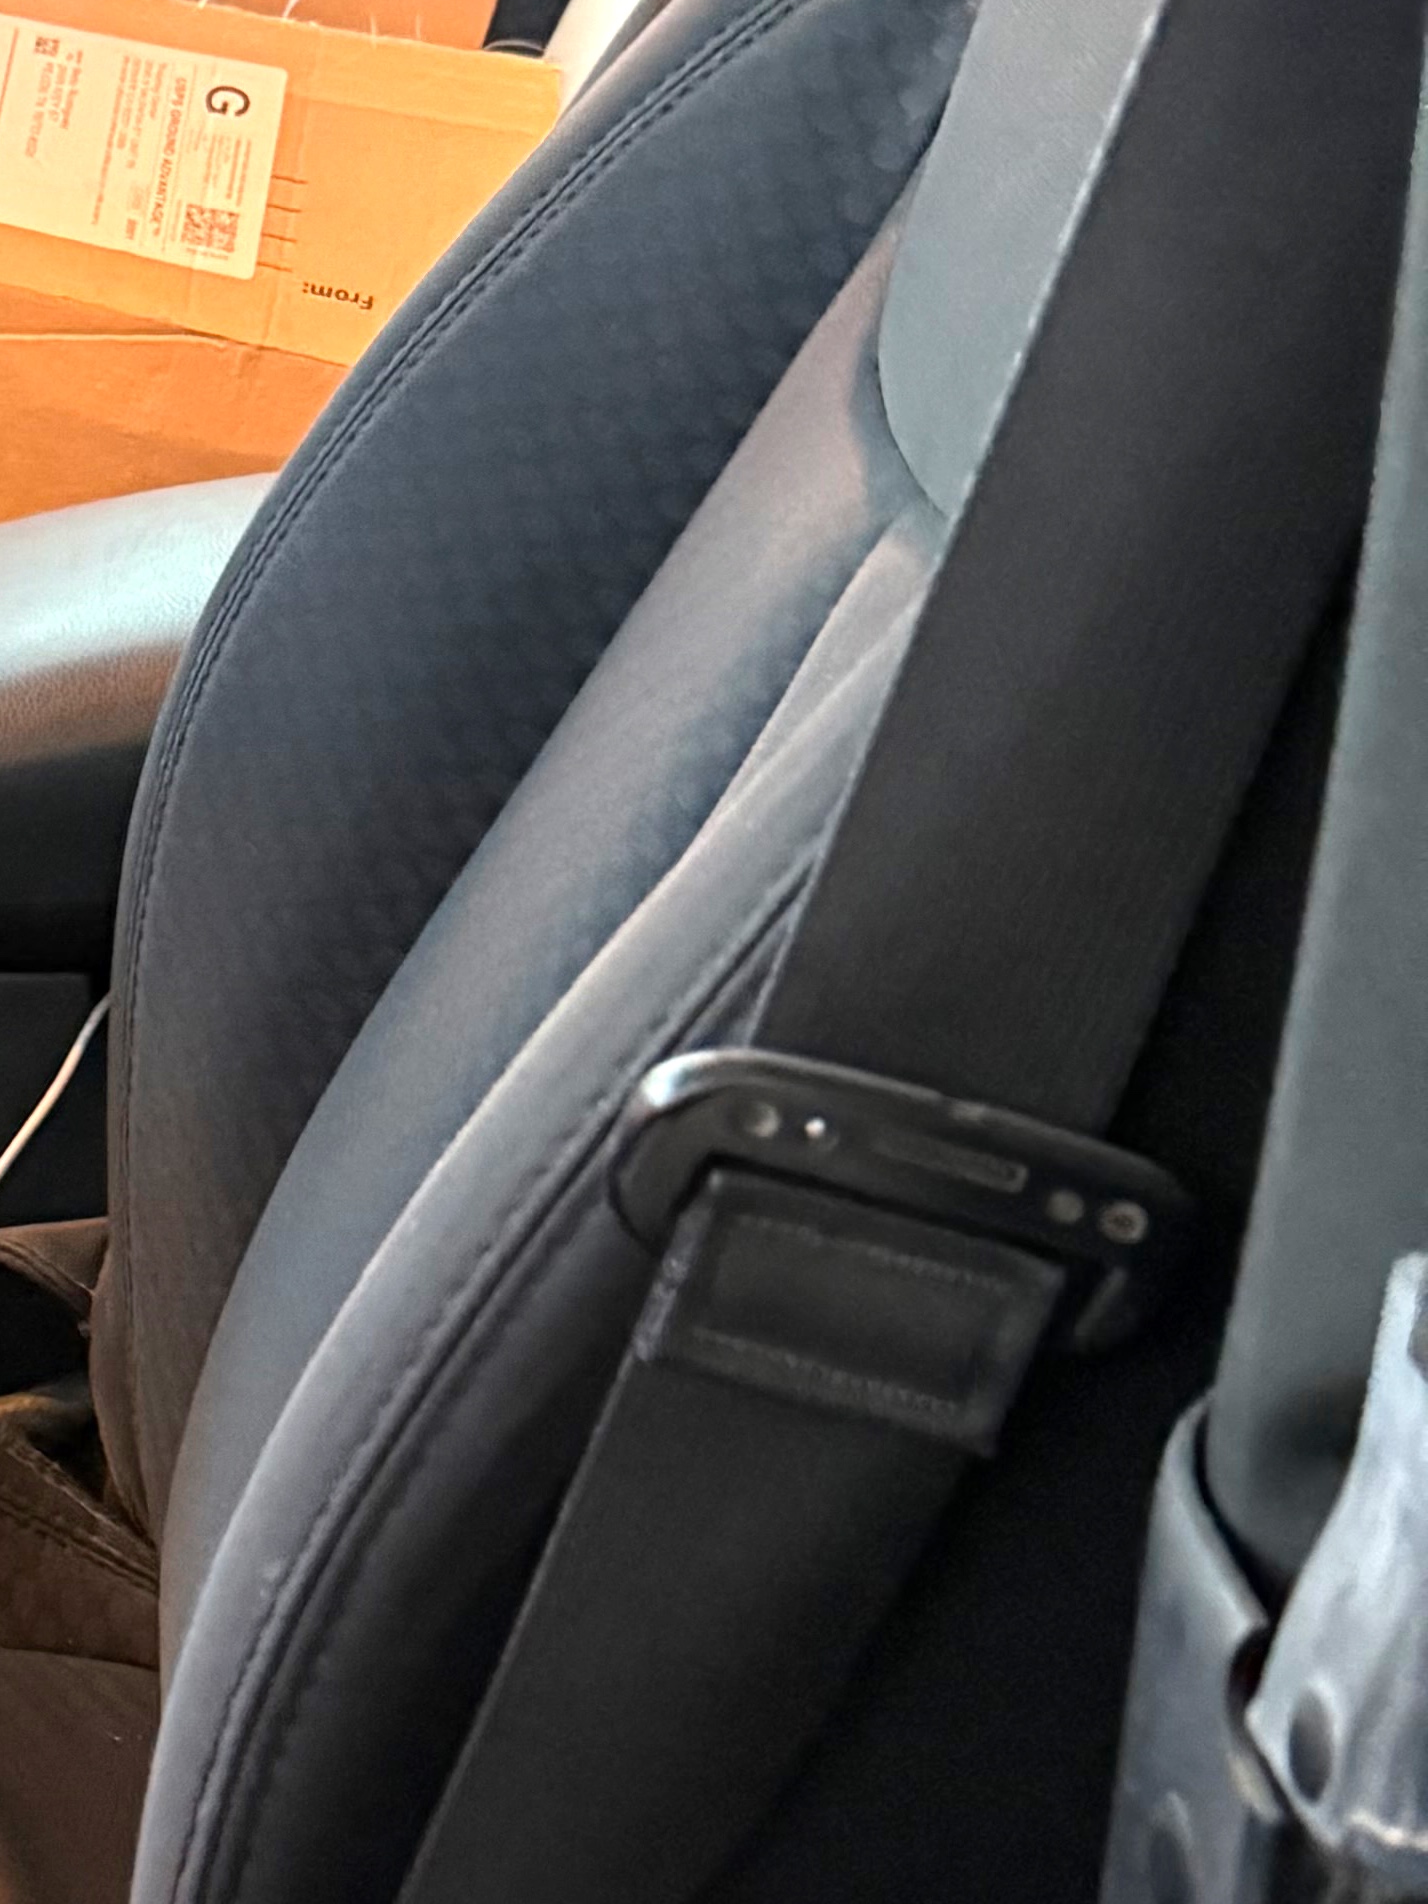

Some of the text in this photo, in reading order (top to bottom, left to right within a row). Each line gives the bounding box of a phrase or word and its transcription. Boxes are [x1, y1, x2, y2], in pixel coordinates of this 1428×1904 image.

[205, 86, 250, 116] G
[162, 108, 182, 156] GROUND
[302, 281, 373, 310] From:
